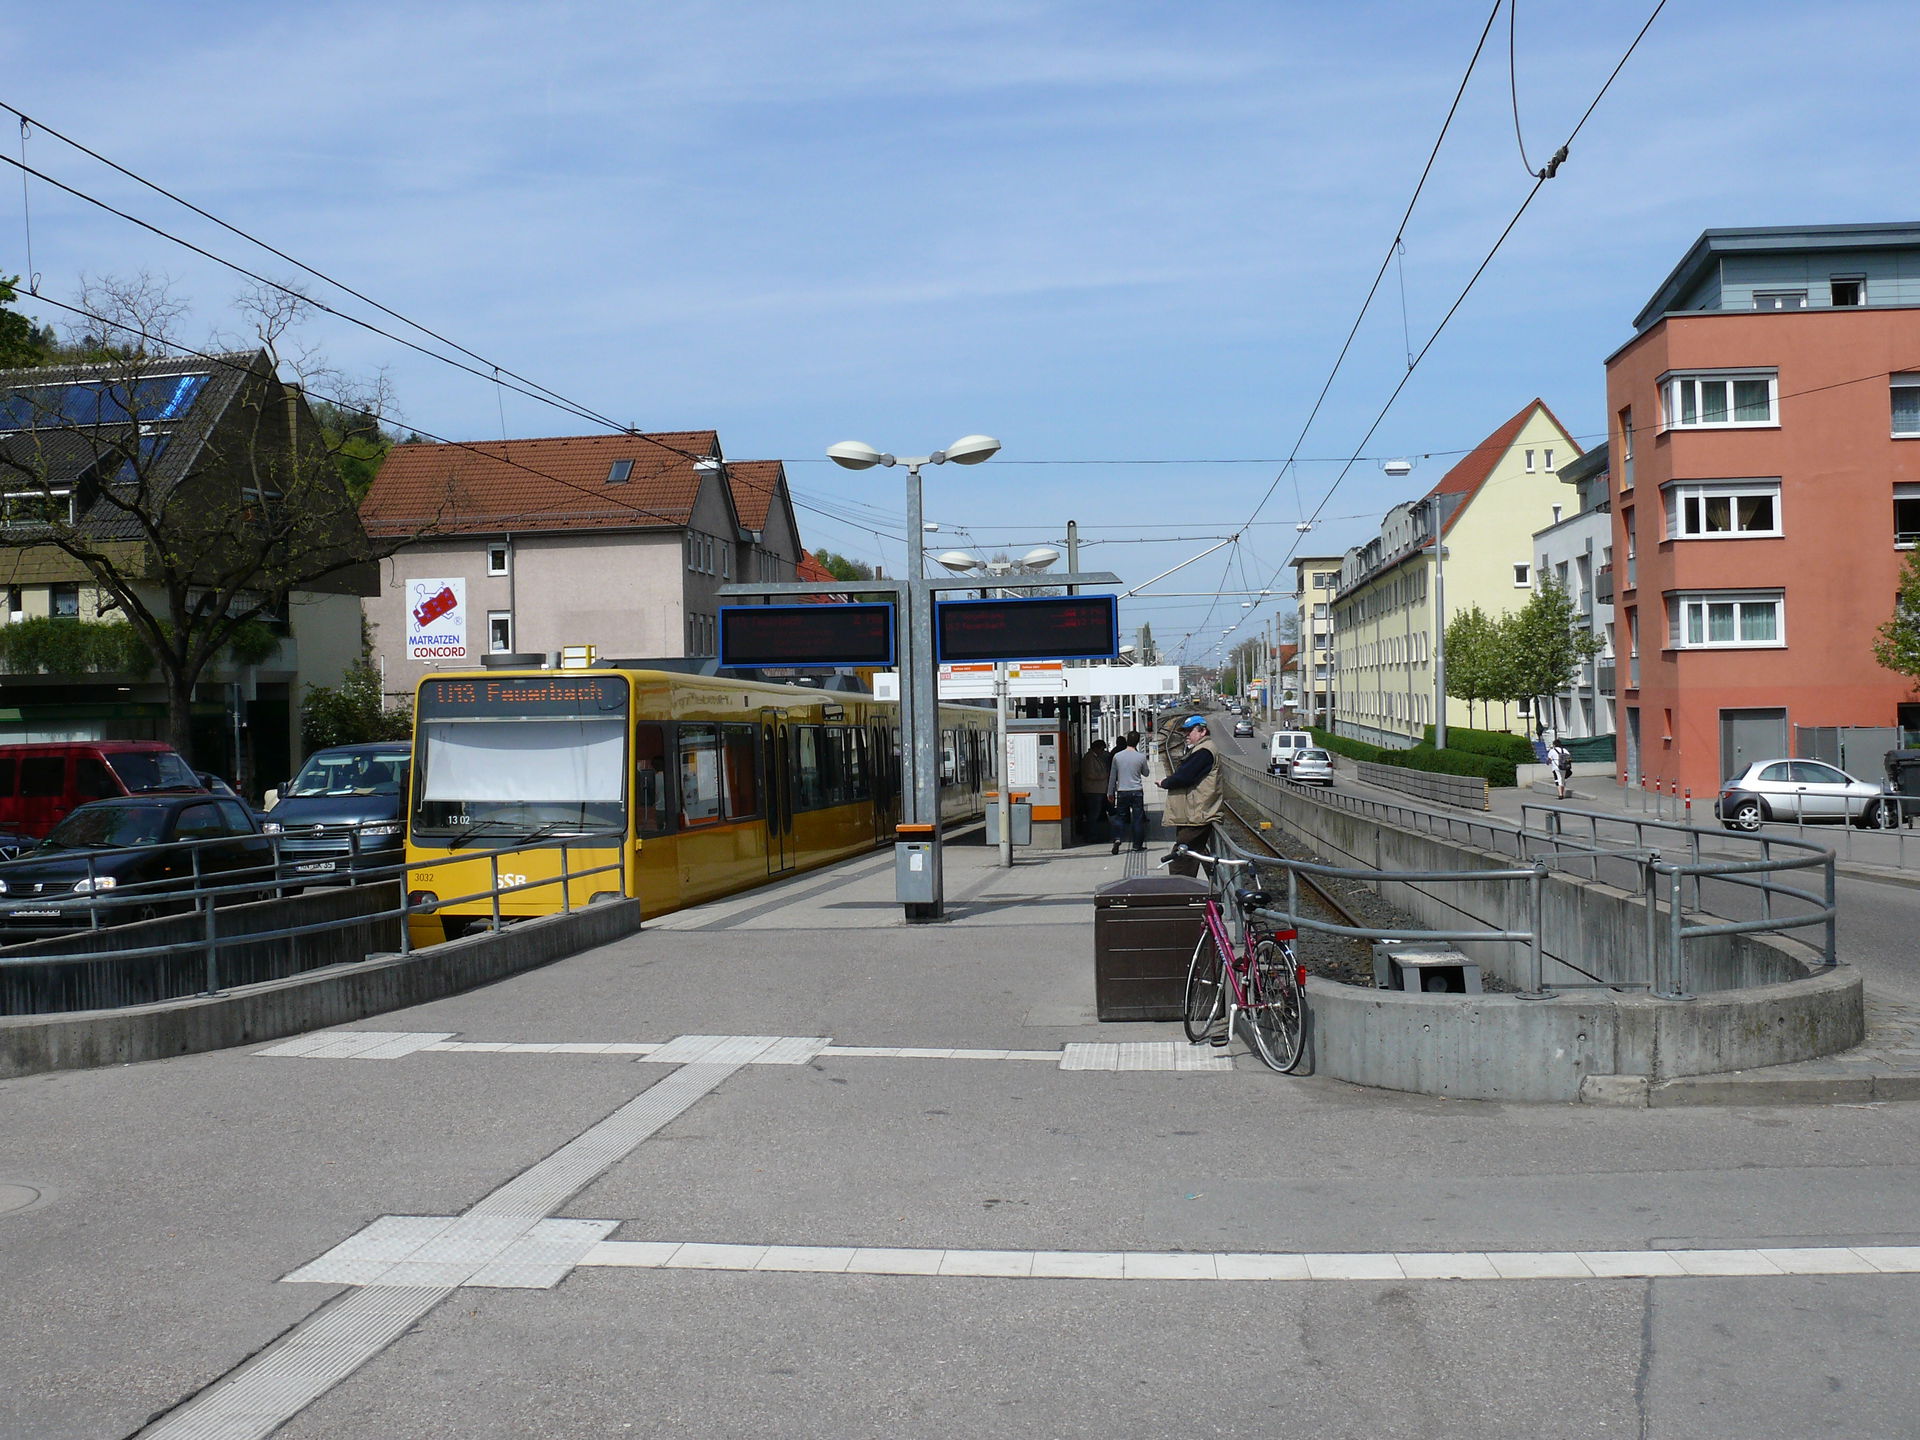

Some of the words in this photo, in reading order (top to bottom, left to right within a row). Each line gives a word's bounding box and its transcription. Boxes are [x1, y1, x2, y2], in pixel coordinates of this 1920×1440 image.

[408, 635, 460, 646] MATRATZEN
[413, 646, 466, 658] CONCORD
[437, 684, 476, 703] U13
[448, 815, 458, 825] 13
[459, 815, 470, 825] 02
[414, 872, 434, 882] 3032
[497, 873, 527, 889] SSB
